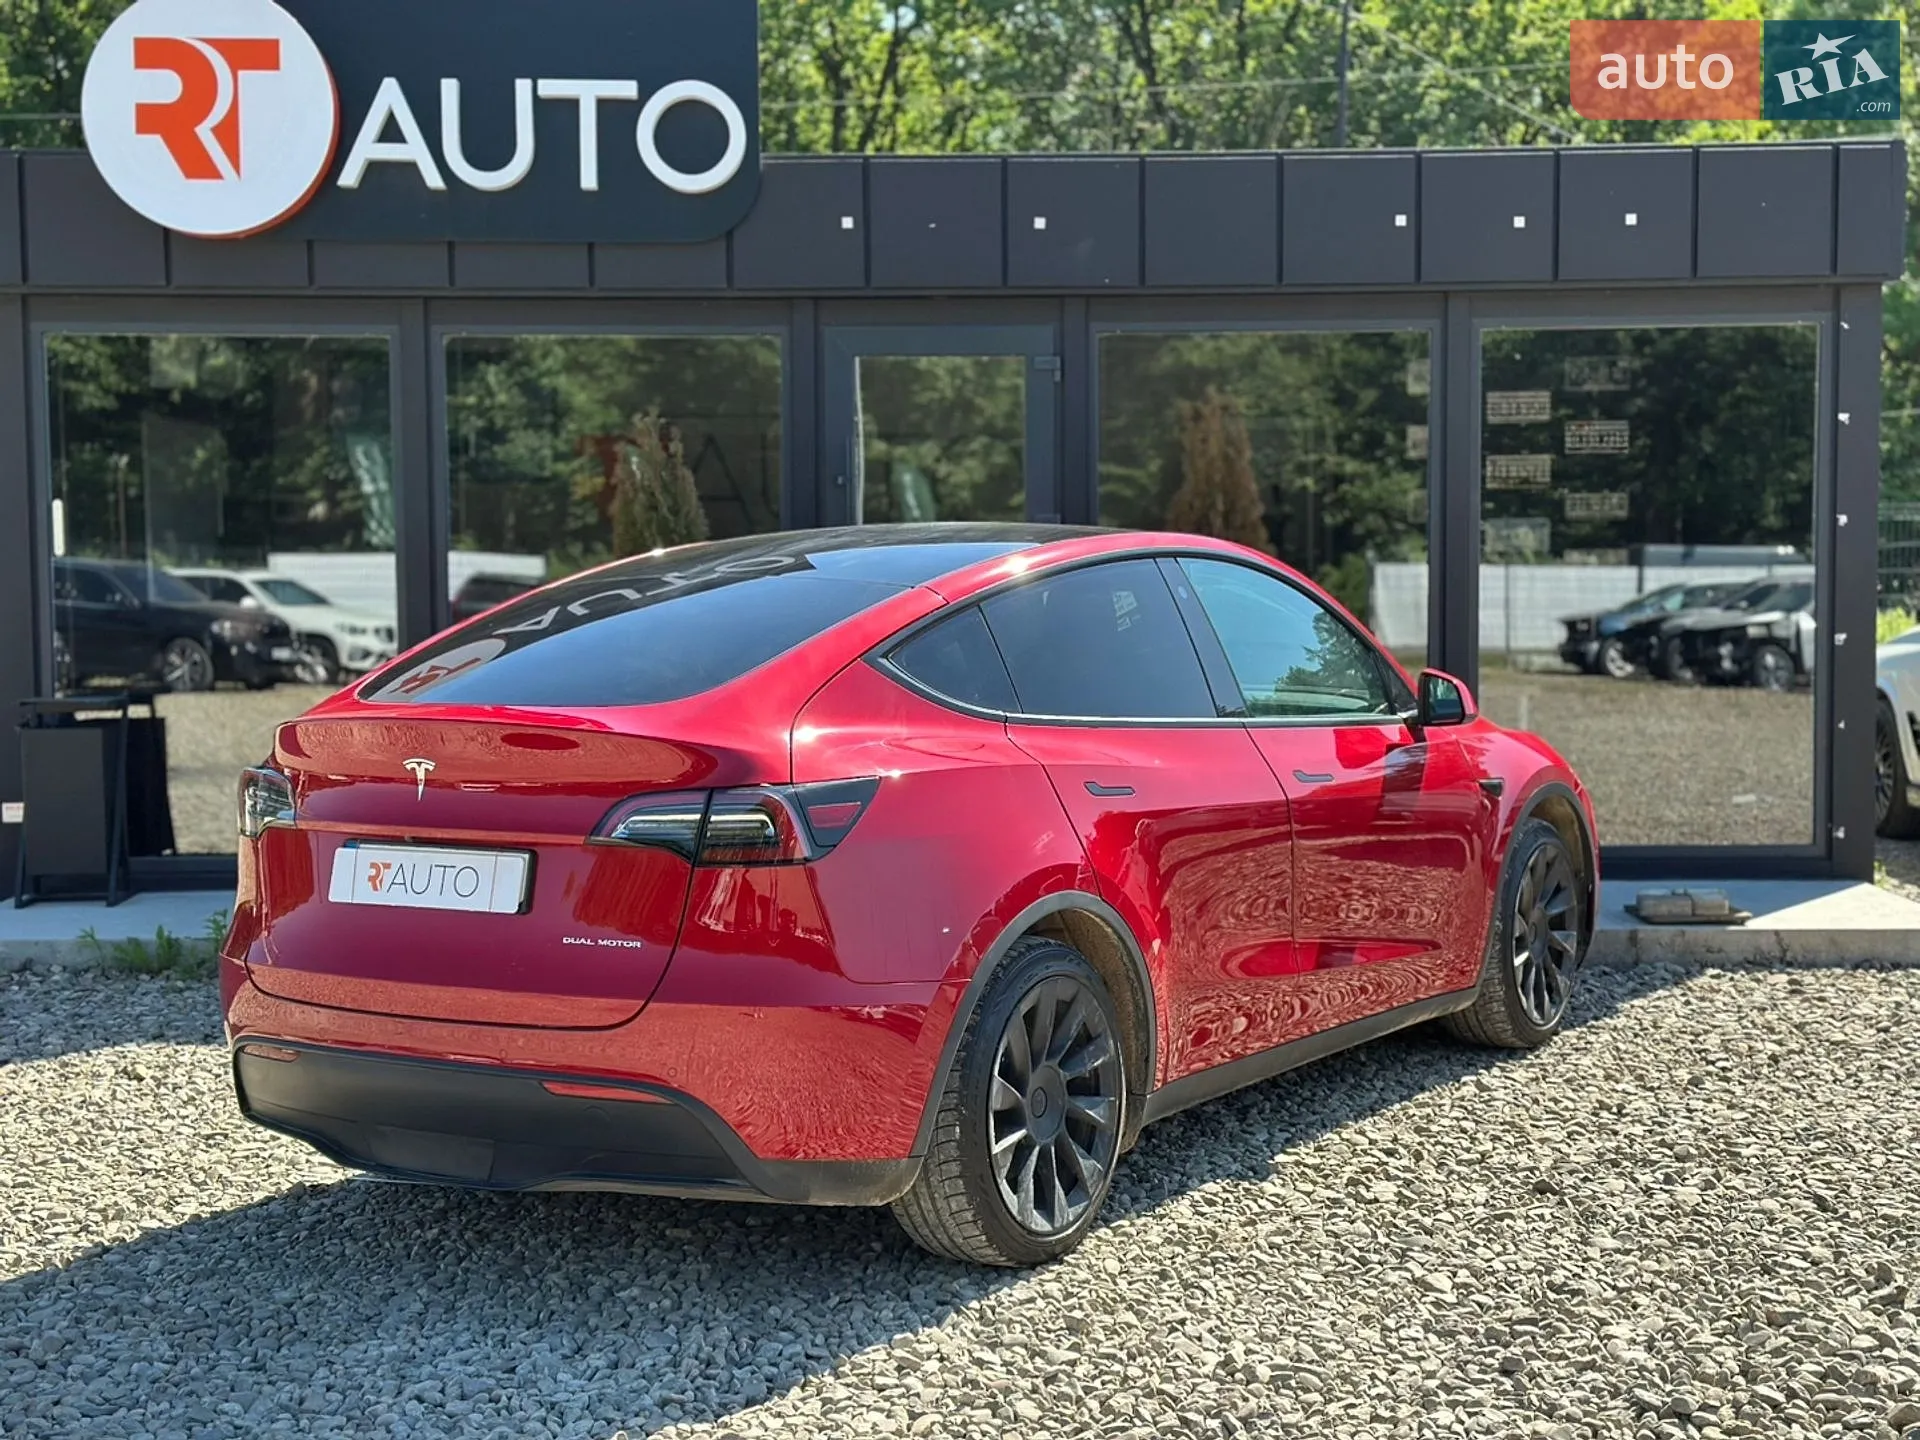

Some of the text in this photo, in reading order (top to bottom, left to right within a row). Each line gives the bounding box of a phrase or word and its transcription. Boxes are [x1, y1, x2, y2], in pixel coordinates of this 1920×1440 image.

[133, 36, 747, 193] RT AUTO
[386, 863, 480, 898] AUTO
[562, 937, 642, 949] DUAL MOTOR
